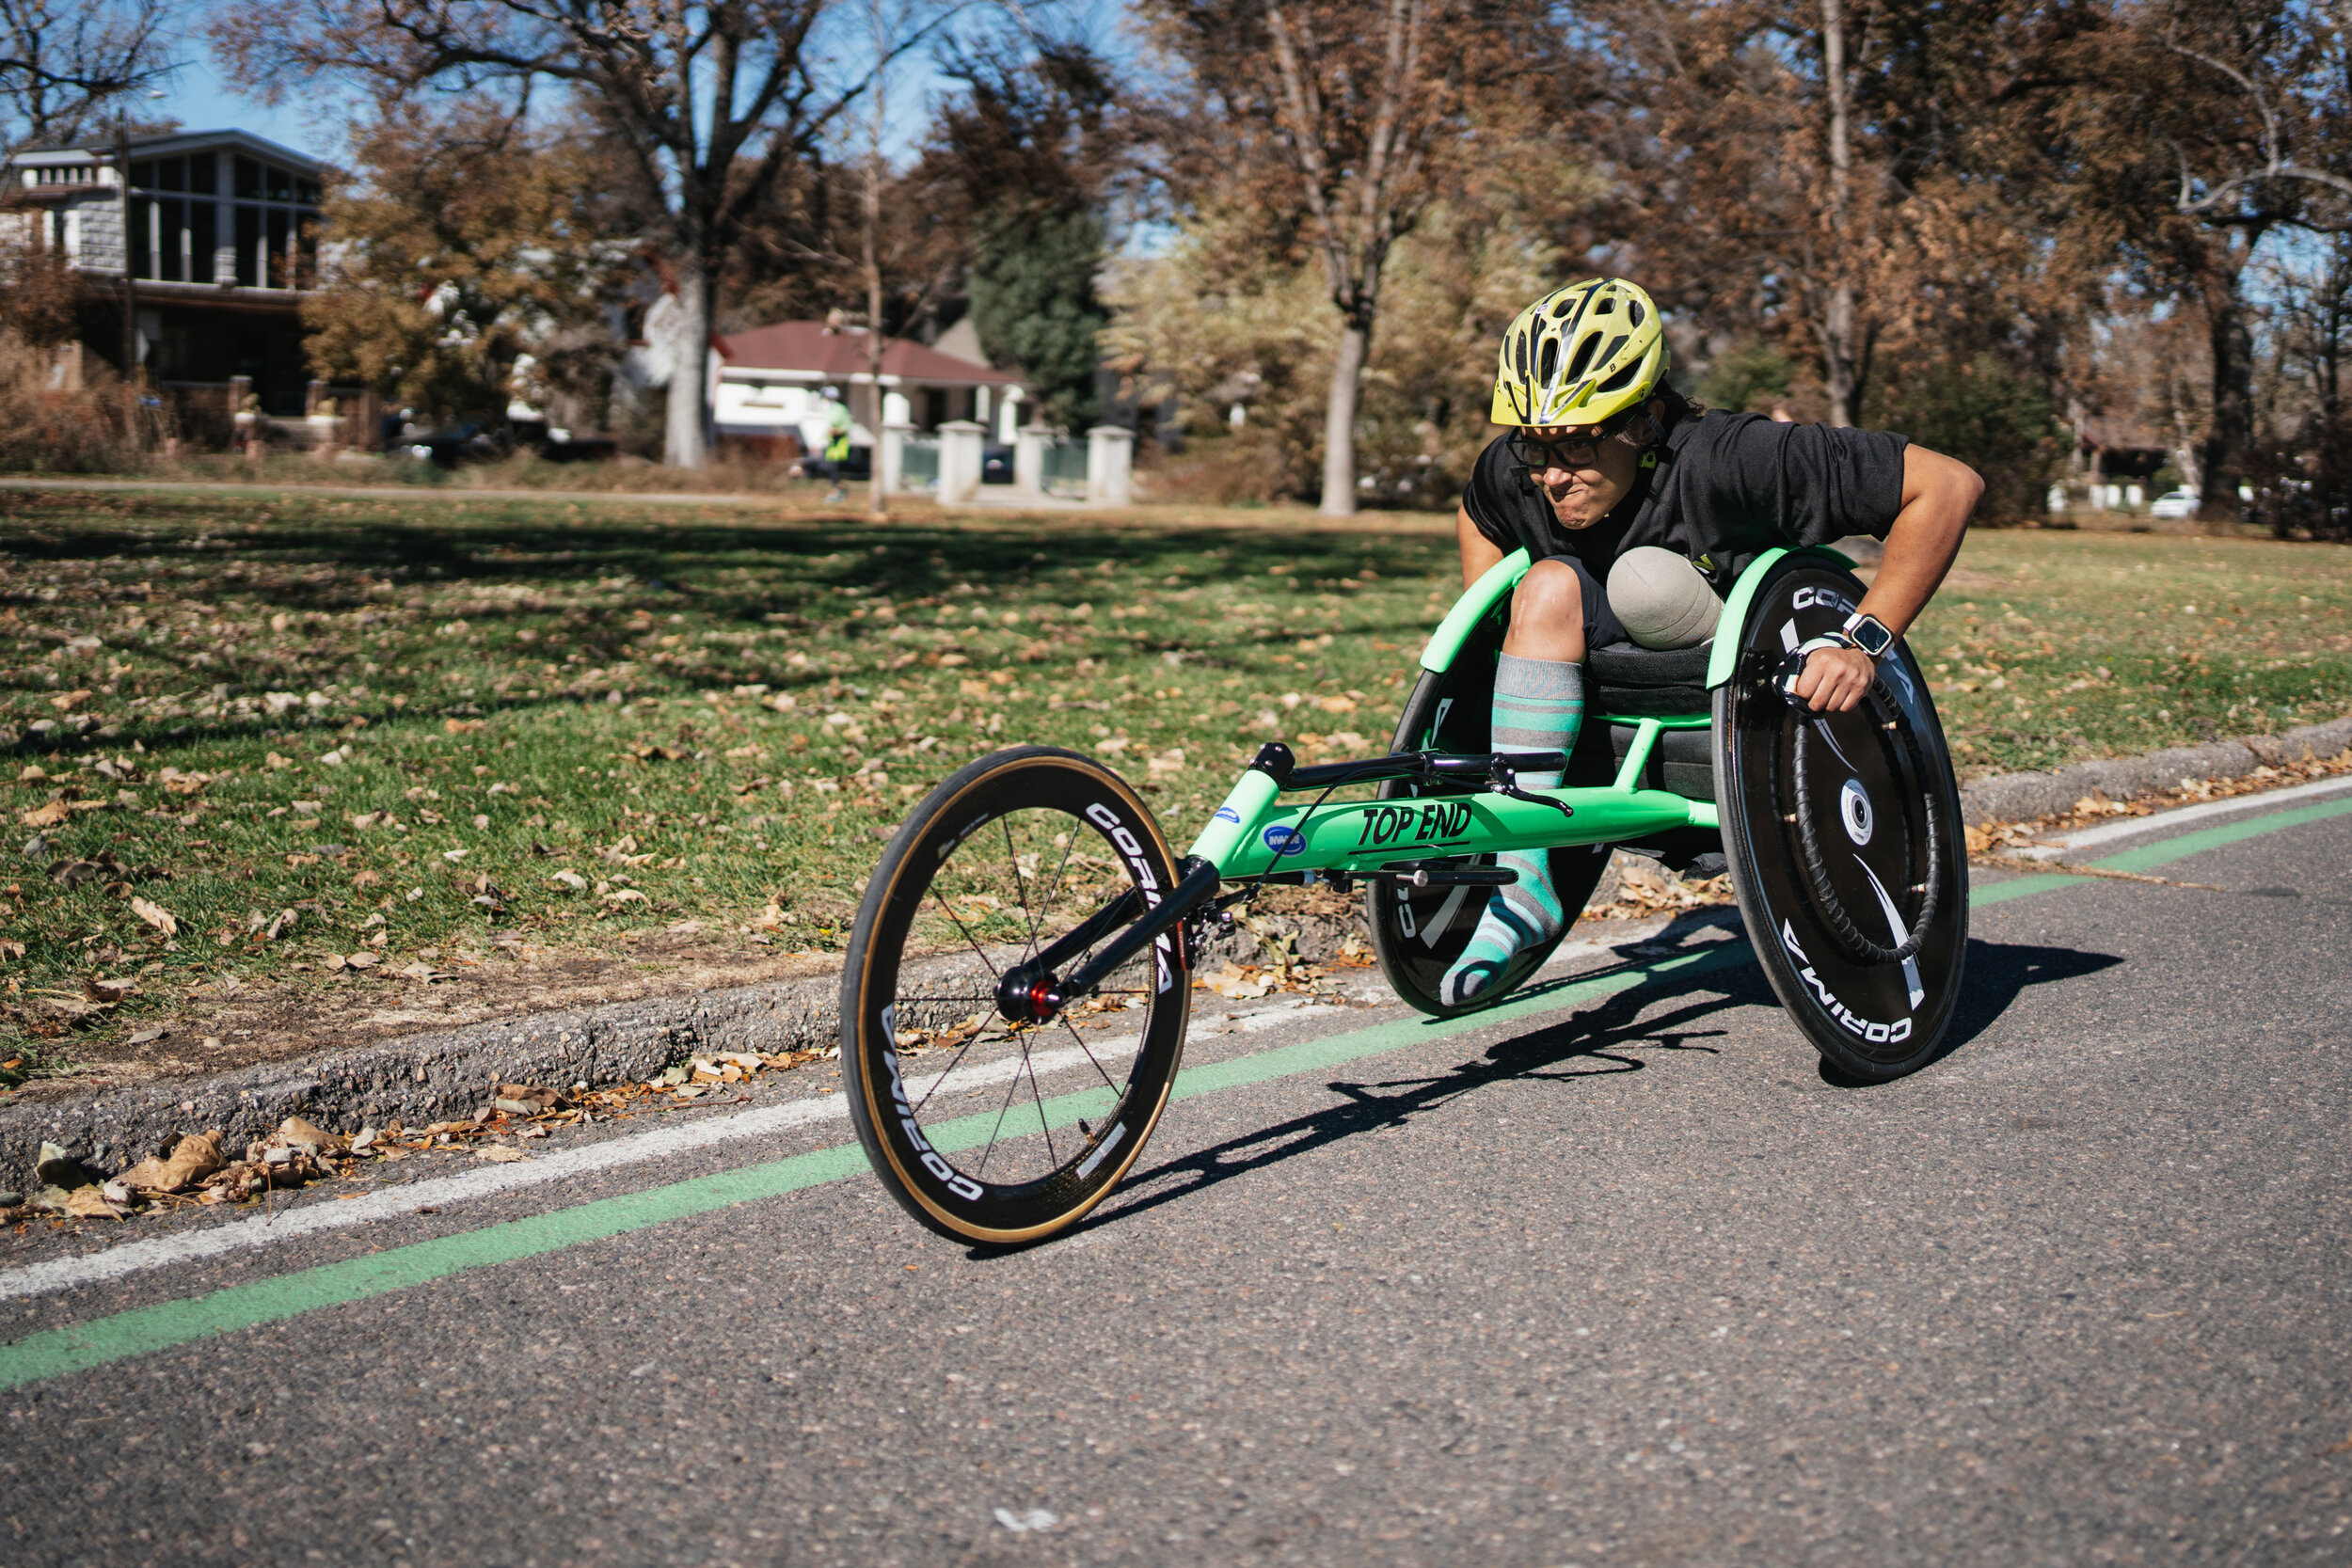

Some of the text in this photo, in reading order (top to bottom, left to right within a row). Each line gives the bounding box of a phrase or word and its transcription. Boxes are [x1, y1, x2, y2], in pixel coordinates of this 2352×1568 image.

[1358, 802, 1472, 846] TOP END
[1783, 917, 1913, 1043] CORIMA
